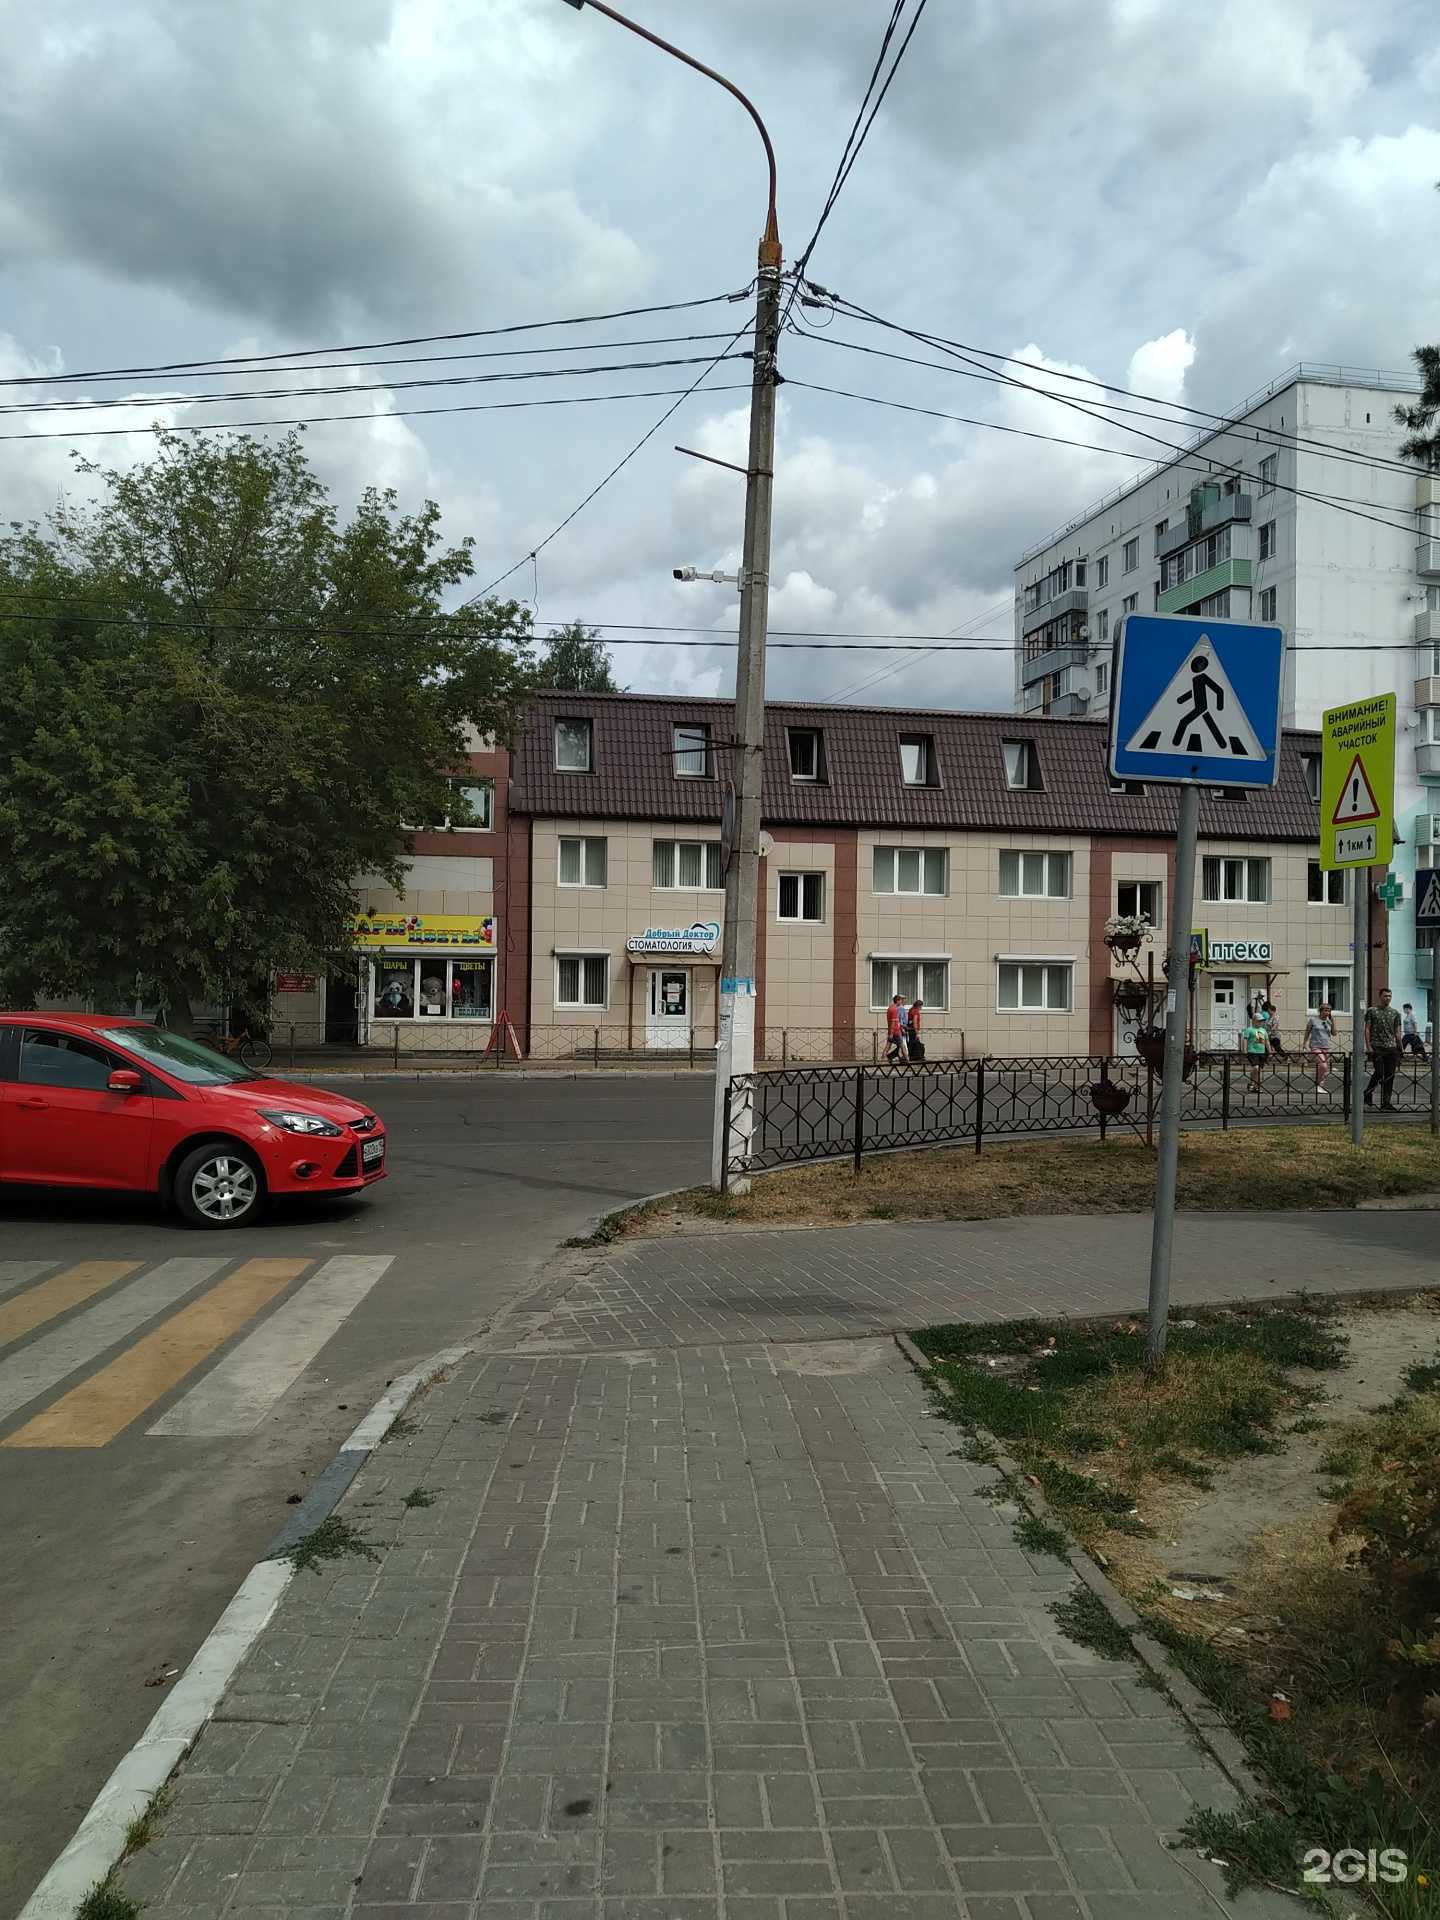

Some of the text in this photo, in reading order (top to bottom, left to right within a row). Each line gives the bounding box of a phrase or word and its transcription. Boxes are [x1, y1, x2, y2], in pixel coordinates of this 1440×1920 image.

[1327, 700, 1389, 725] ВНИМАНИЕ!
[1331, 714, 1386, 738] АВАРИЙНЫЙ
[1338, 733, 1378, 752] УЧАСТОК
[408, 929, 480, 944] ЦВЕТЫ
[645, 929, 715, 940] Добрый Доктор
[628, 940, 692, 951] СТОМАТОЛОГИЯ
[1211, 943, 1271, 959] птека
[383, 961, 407, 970] ШАРЫ
[460, 961, 485, 971] ЦВЕТЫ
